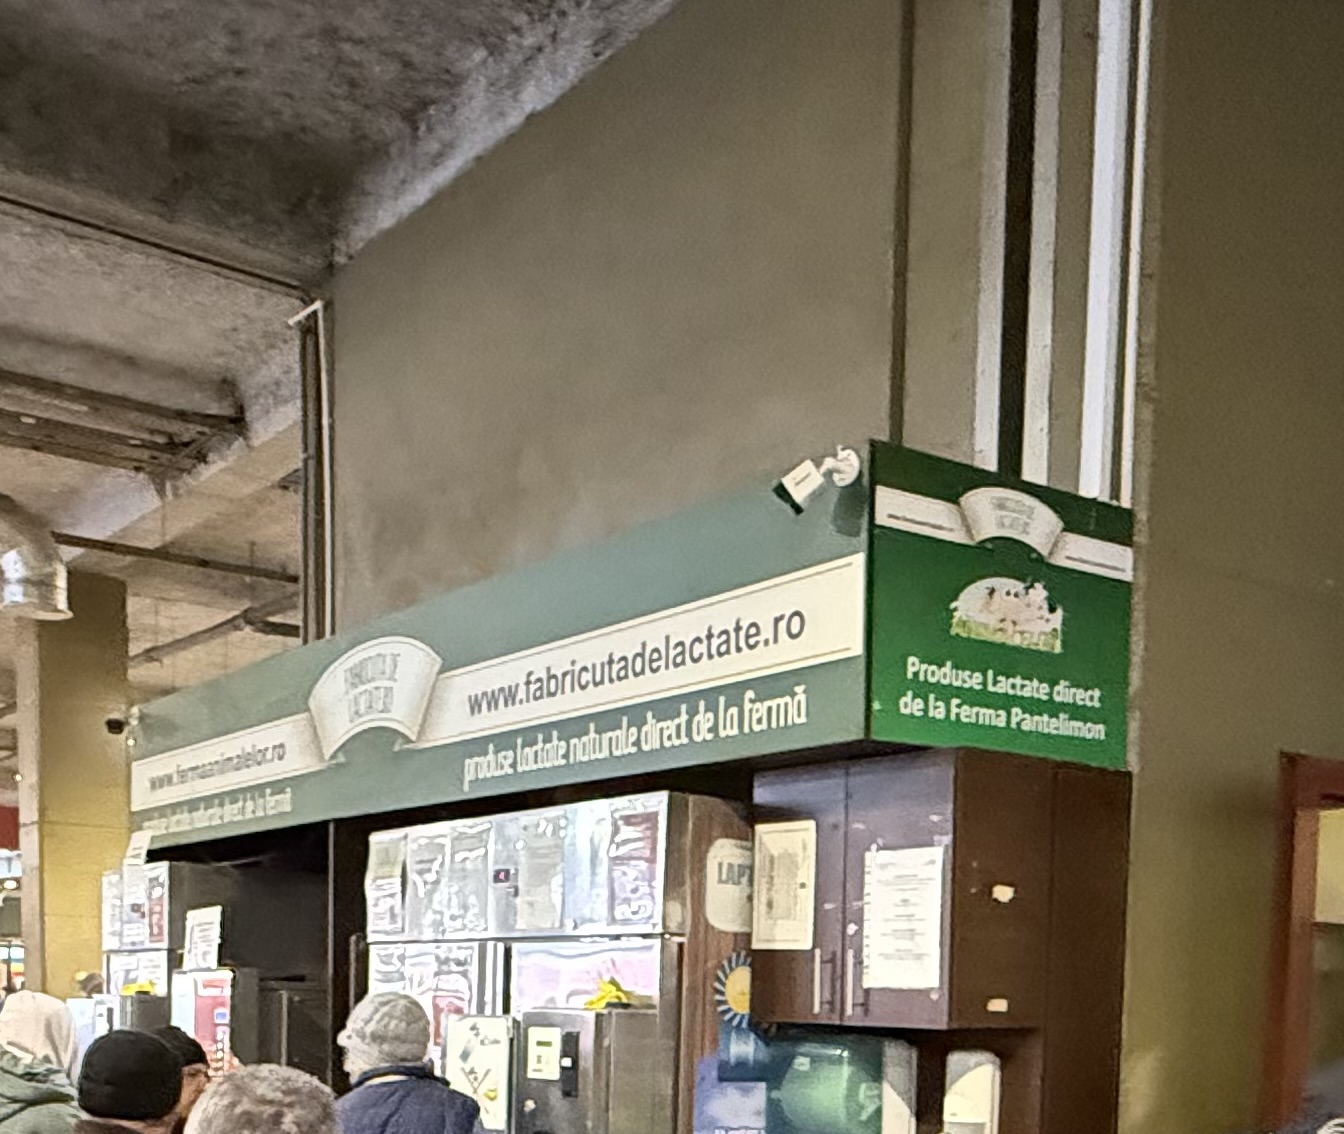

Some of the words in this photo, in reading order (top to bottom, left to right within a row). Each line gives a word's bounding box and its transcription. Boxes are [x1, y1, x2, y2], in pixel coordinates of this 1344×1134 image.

[468, 609, 806, 717] www.fabricutadelactate.ro
[906, 656, 984, 690] Produse
[986, 669, 1050, 700] Lactate
[1053, 680, 1101, 708] direct
[463, 743, 514, 793] produse
[516, 731, 567, 773] lactate
[569, 716, 638, 764] naturale
[640, 704, 688, 750] direct
[692, 700, 715, 740] de
[718, 696, 739, 737] la
[743, 685, 807, 734] fermă
[899, 691, 924, 716] de
[928, 693, 946, 719] la
[950, 698, 1007, 728] Ferma
[1010, 707, 1105, 740] Pantelimon
